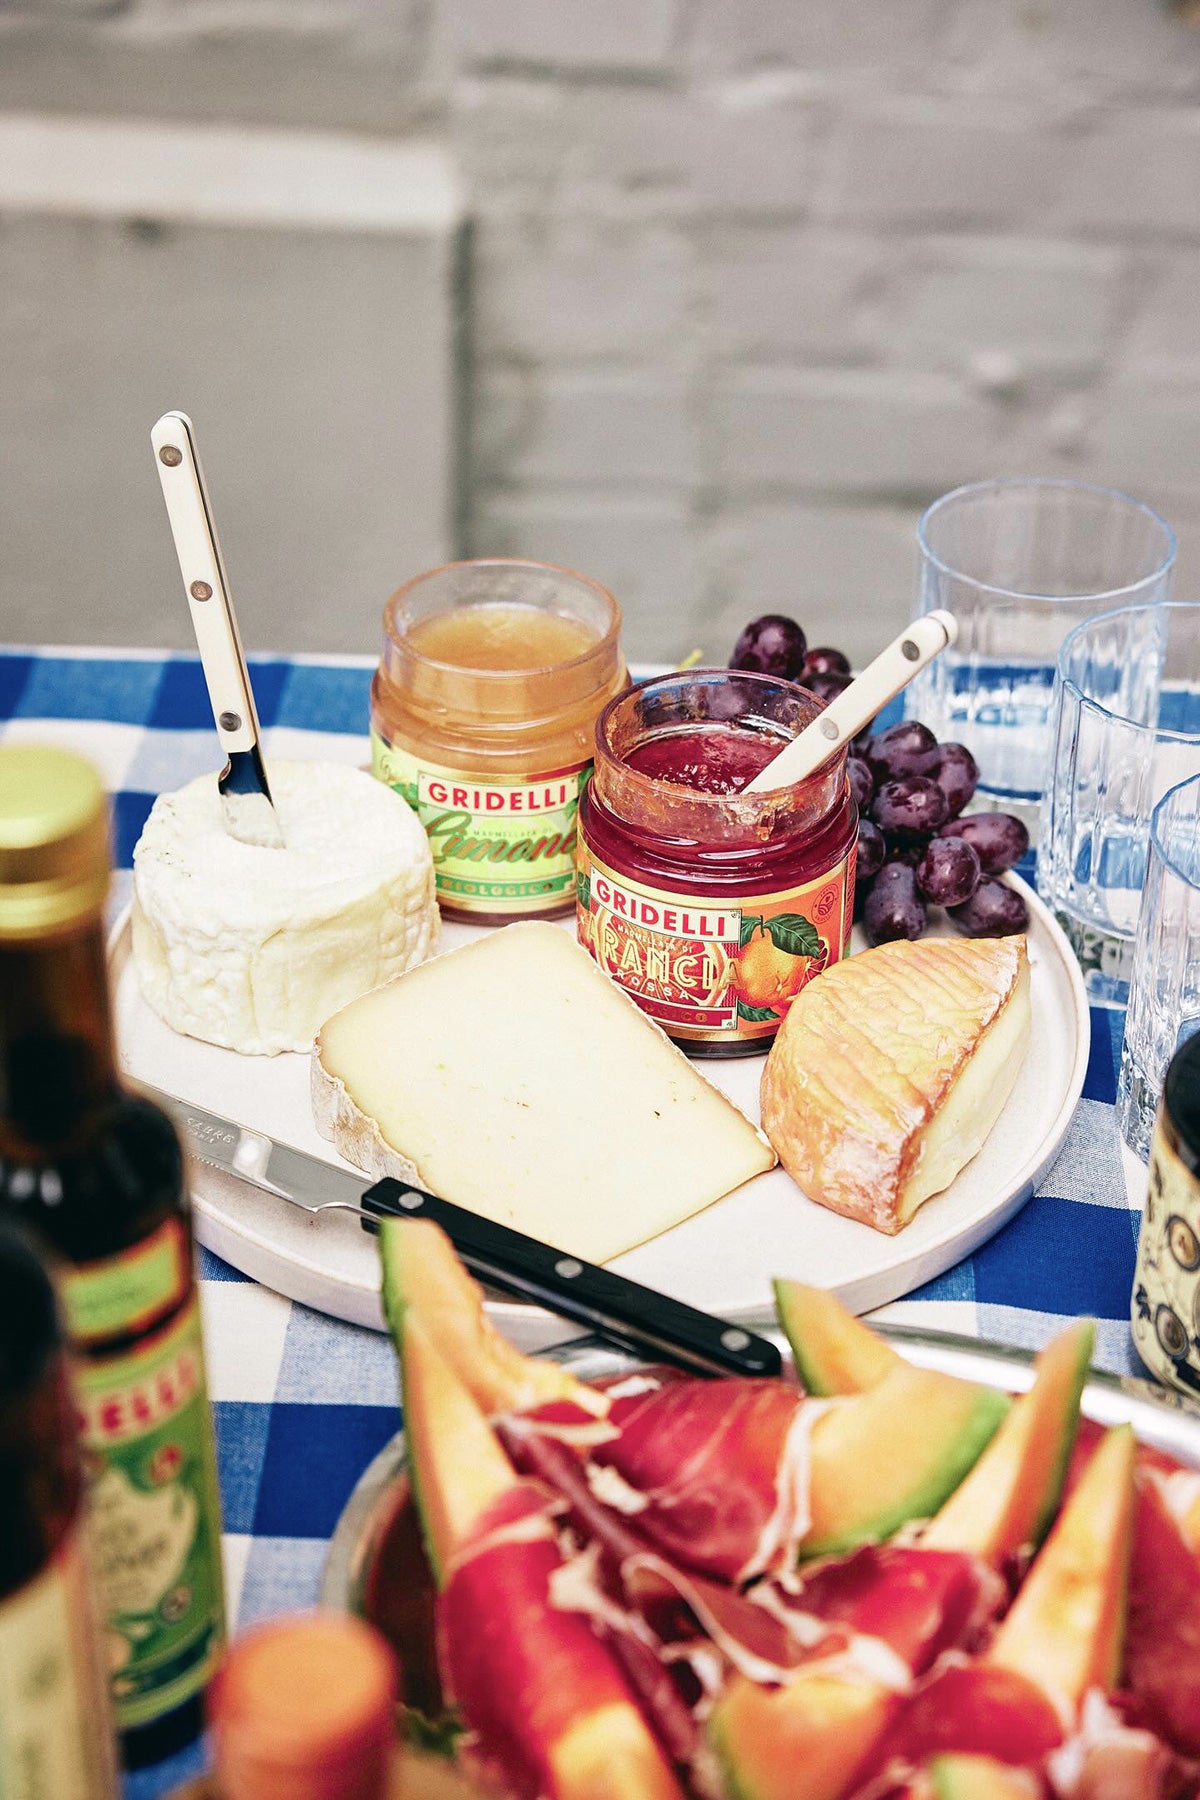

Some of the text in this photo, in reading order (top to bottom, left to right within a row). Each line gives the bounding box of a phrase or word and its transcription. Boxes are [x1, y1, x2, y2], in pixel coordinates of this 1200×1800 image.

[428, 782, 567, 811] GRIDELLI
[596, 879, 725, 937] GRIDELLI
[587, 913, 740, 992] ARANCIA
[617, 924, 692, 953] MARMELLATA DI
[617, 968, 689, 1000] ROSSA
[644, 1002, 708, 1023] OGICO
[186, 1117, 234, 1143] SABRE
